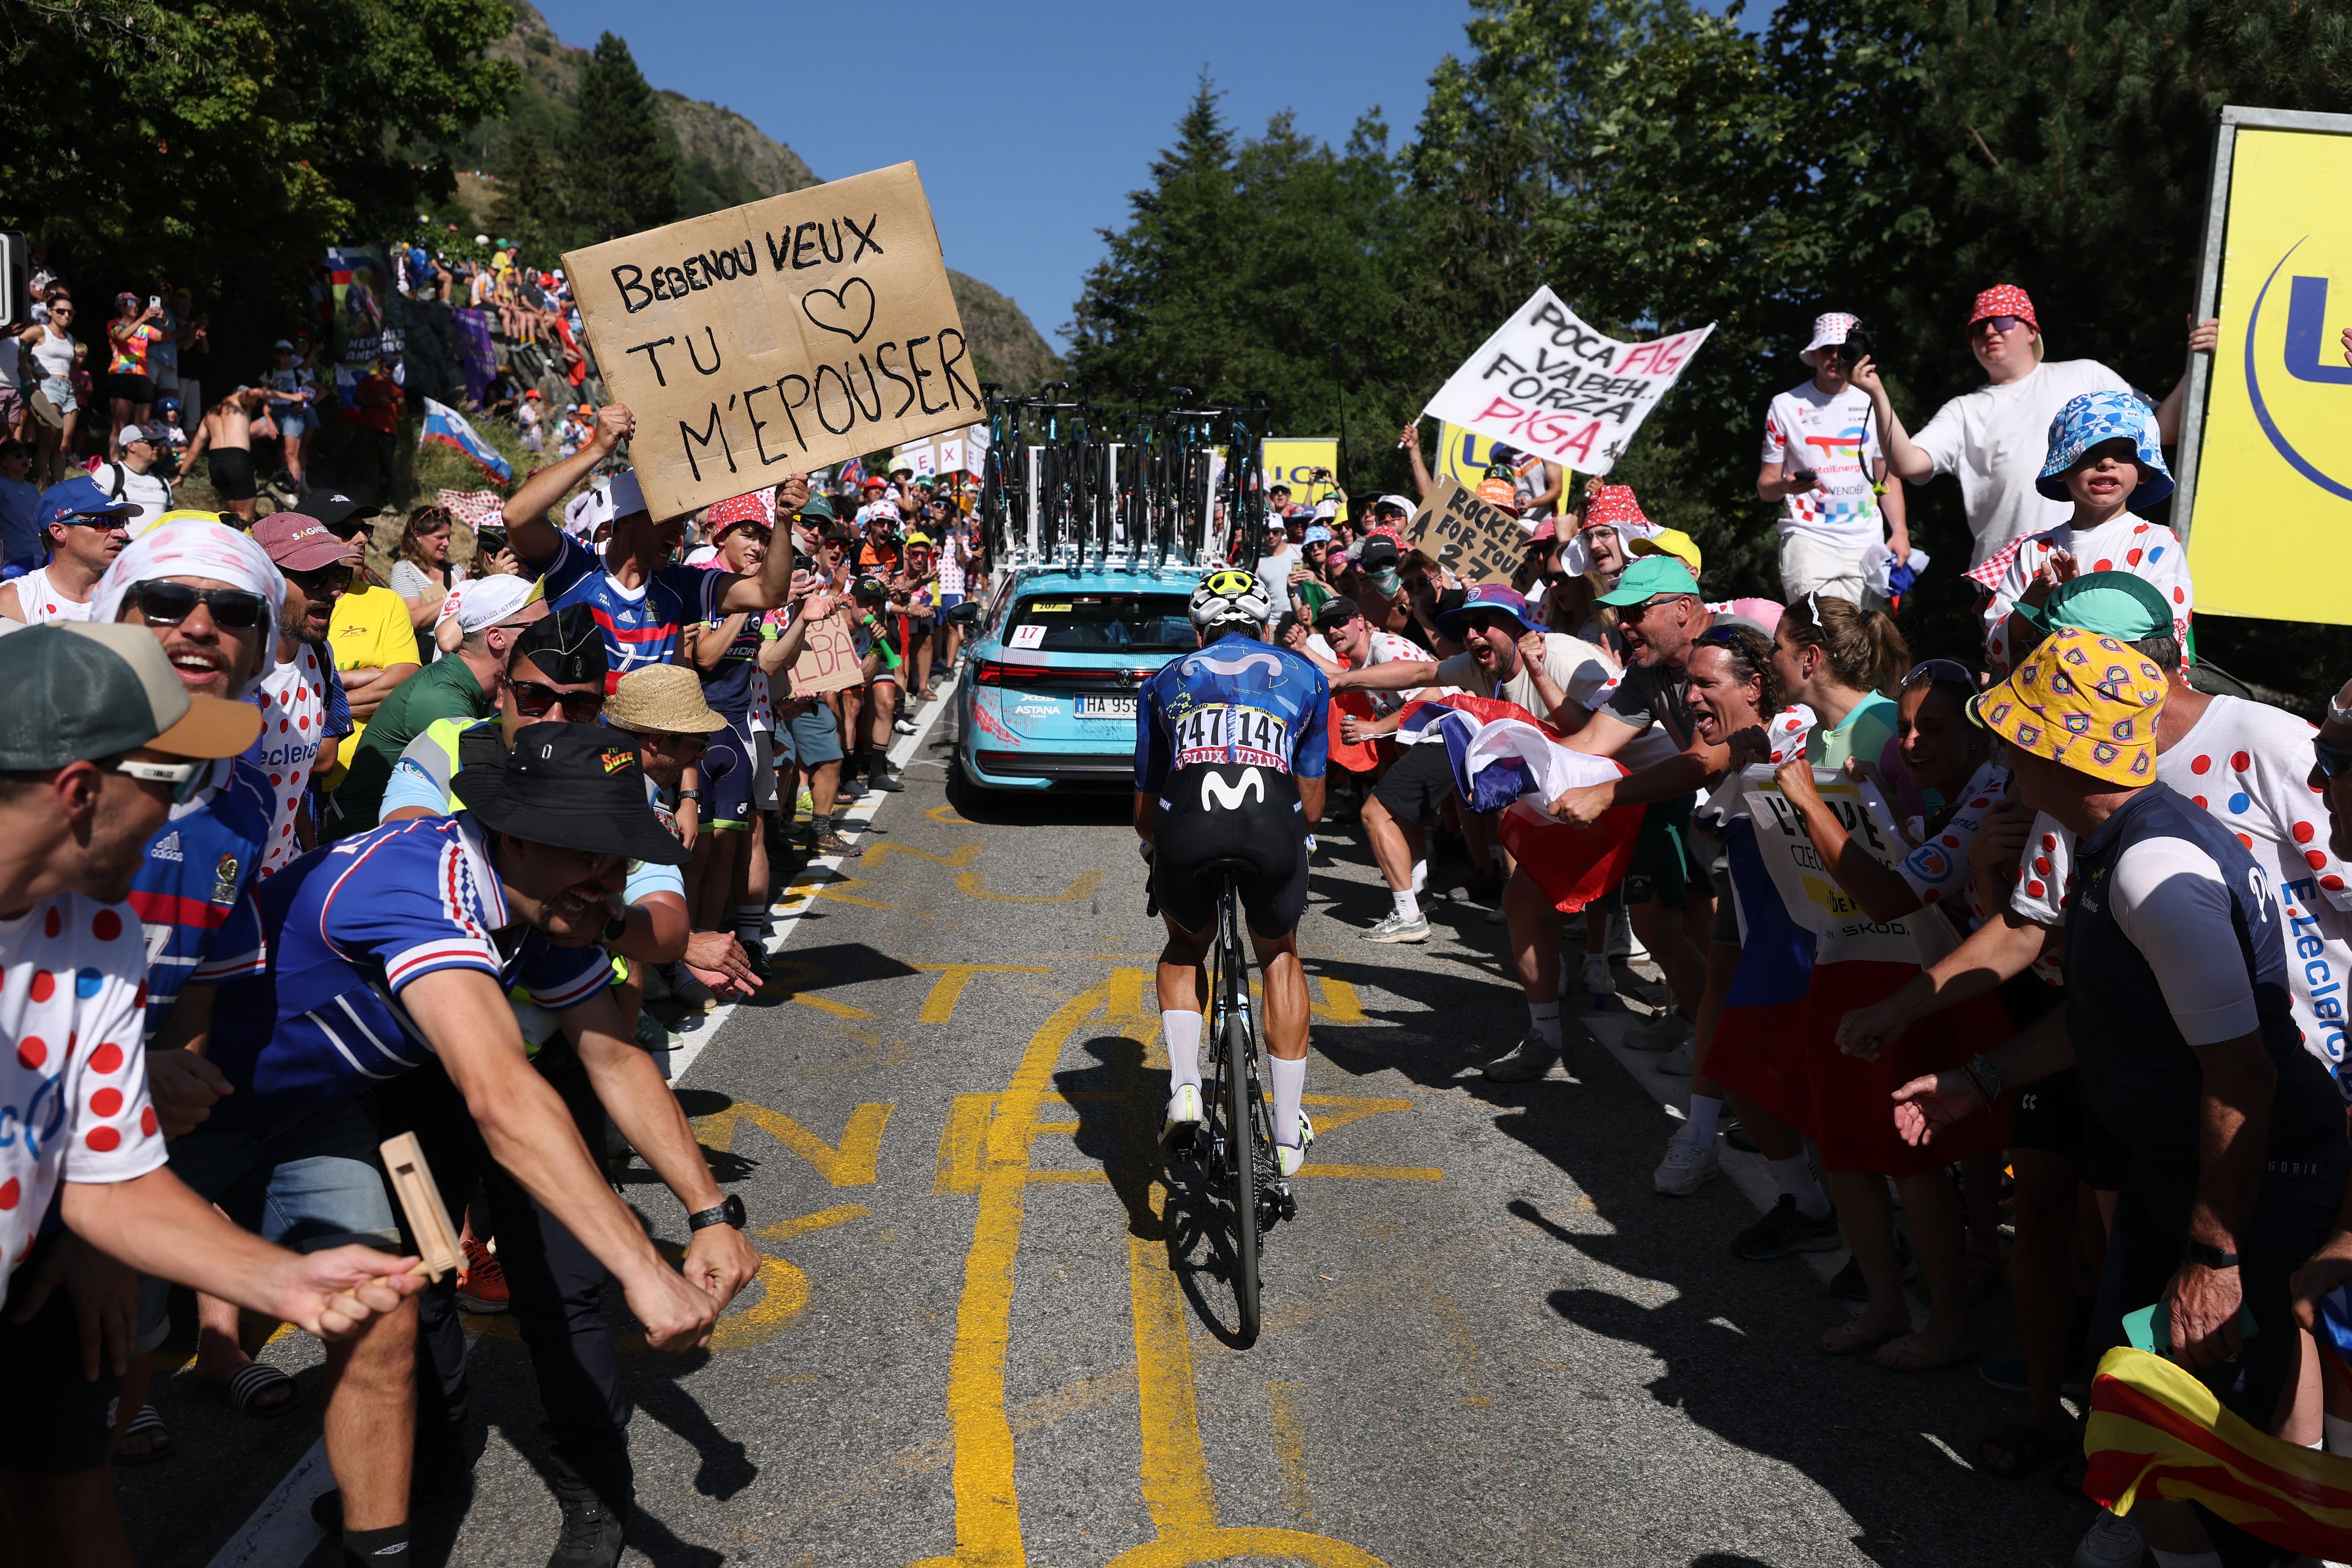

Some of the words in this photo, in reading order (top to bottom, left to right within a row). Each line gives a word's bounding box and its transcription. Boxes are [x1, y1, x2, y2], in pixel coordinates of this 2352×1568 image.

[612, 239, 756, 313] BEBENOU
[766, 213, 883, 271] VEUX
[1530, 302, 1616, 368] POCA
[1614, 335, 1694, 375] FIG
[626, 325, 721, 387] TU
[1483, 353, 1635, 423] FORZA
[679, 327, 982, 481] M'EPOUSER
[972, 427, 988, 442] Allez
[1471, 397, 1602, 463] PIGA
[1435, 514, 1477, 550] FOR
[1479, 538, 1529, 586] TOUR
[488, 611, 498, 619] LOZE
[509, 598, 522, 608] 2304m
[1020, 627, 1039, 639] 17
[787, 631, 860, 684] LBA
[1015, 706, 1061, 715] ASTANA
[1088, 696, 1105, 712] HA
[1189, 703, 1208, 715] ROMO
[1255, 707, 1273, 718] ROMO
[1178, 709, 1224, 753] 147
[1238, 712, 1283, 757] 147
[601, 751, 633, 772] Suze
[1176, 750, 1225, 770] VELUX
[1235, 751, 1287, 774] VELUX
[151, 848, 183, 862] adidas
[1843, 922, 1910, 937] SKOD
[2280, 877, 2352, 1057] E.Leclerc
[2268, 1161, 2317, 1175] GOBIK
